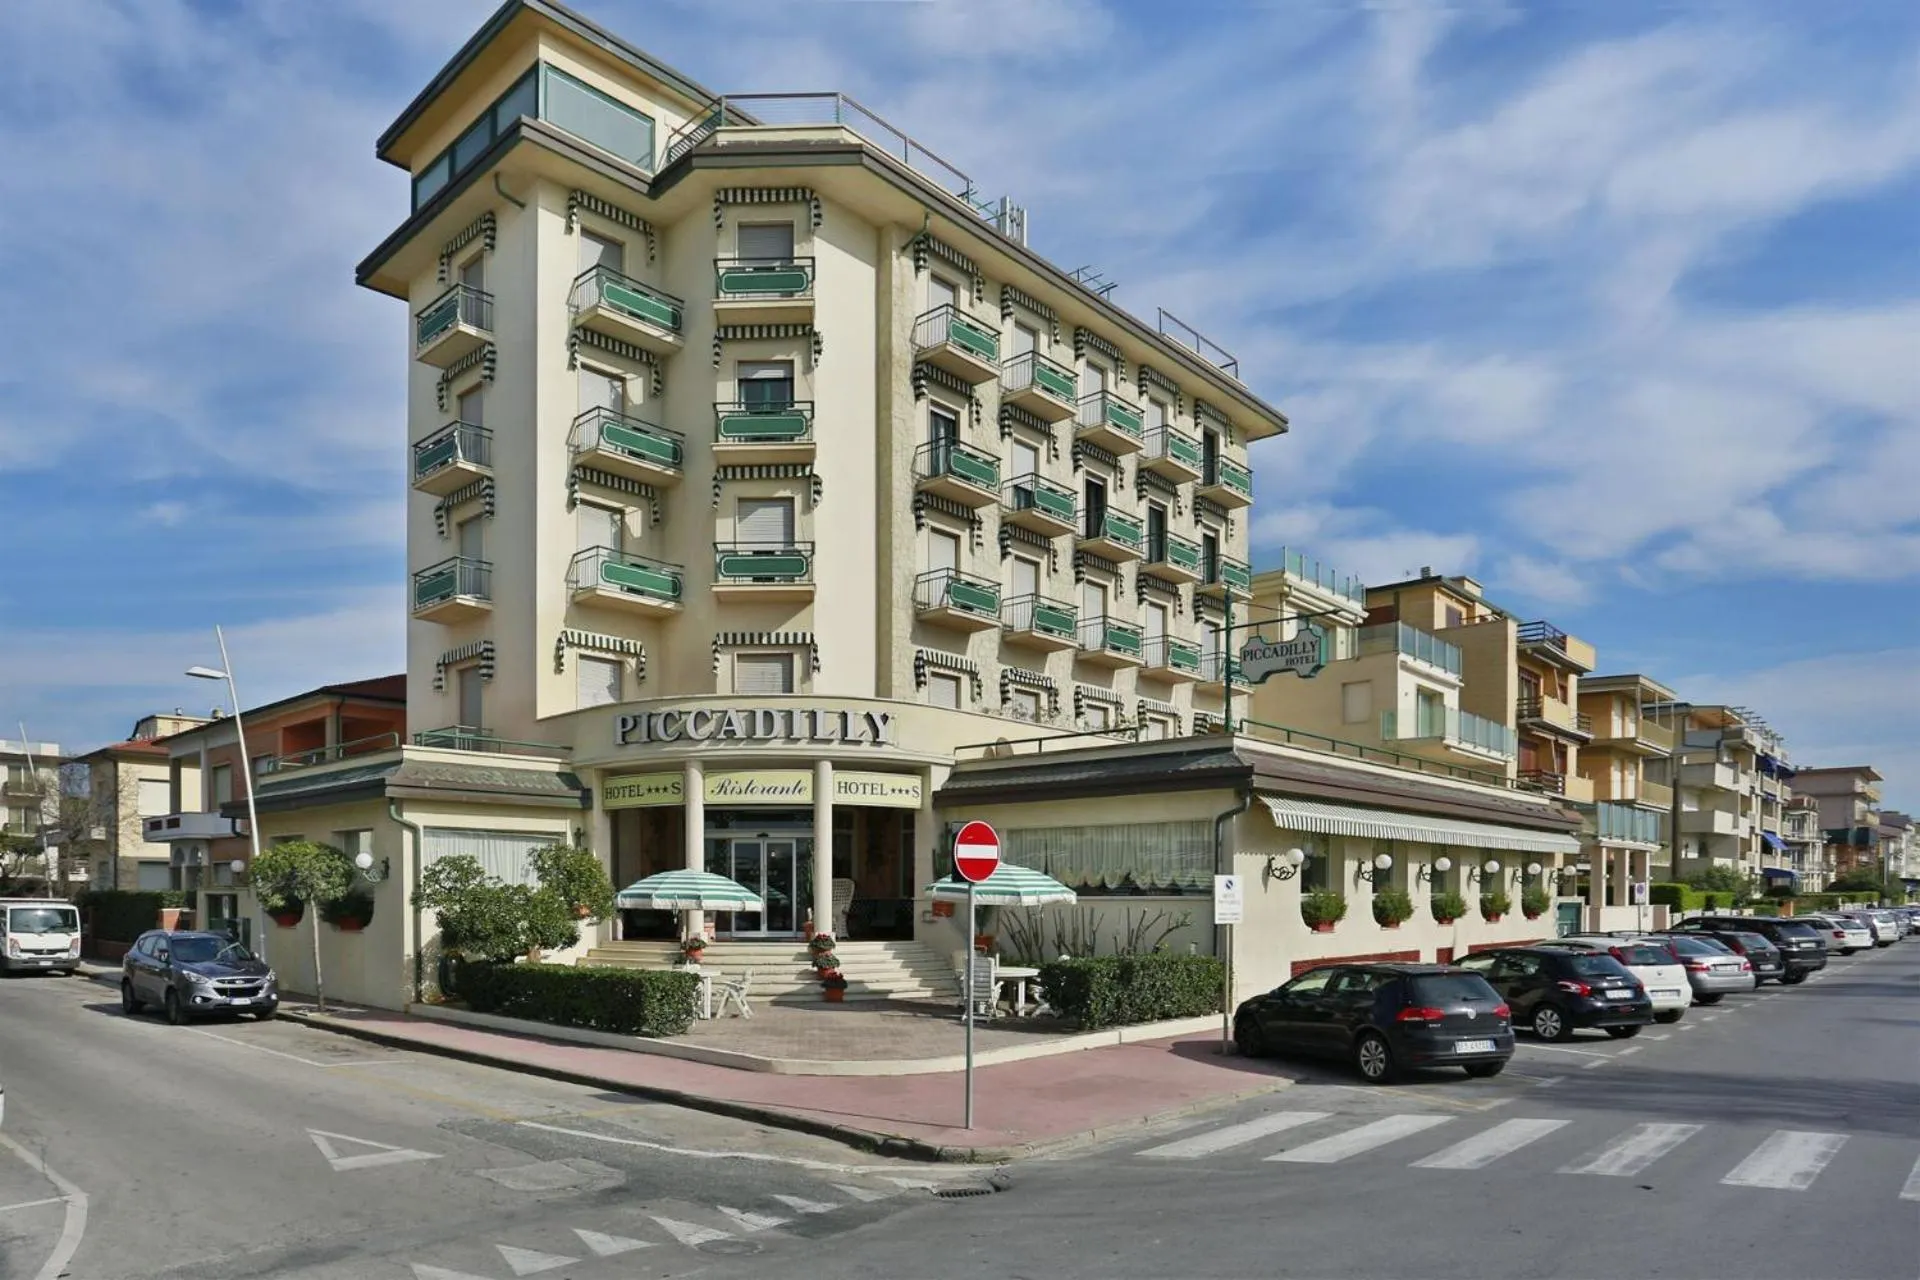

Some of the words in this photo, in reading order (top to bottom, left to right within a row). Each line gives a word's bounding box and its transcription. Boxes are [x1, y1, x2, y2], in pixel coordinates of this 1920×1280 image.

[1243, 640, 1318, 661] PICCADILLY
[1285, 655, 1315, 666] HOTEL
[614, 708, 890, 745] PICCADILLY
[604, 784, 645, 800] HOTEL
[711, 779, 807, 796] Ristorante
[837, 781, 888, 796] HOTEL
